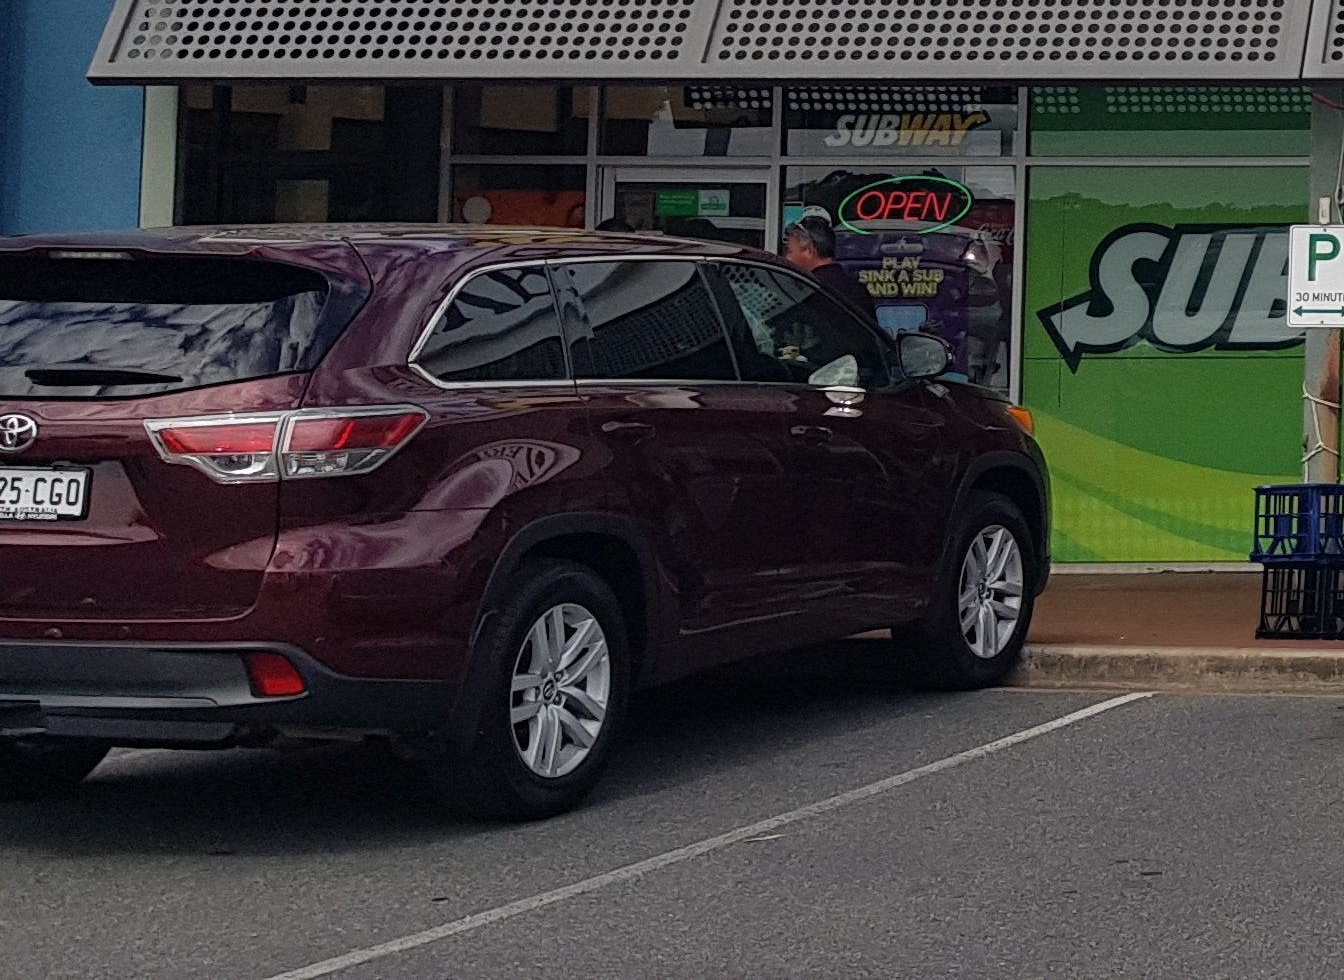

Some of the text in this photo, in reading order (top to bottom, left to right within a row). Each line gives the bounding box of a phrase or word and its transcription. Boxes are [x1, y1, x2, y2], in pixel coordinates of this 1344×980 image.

[823, 112, 987, 147] SUBWAY
[856, 189, 953, 220] OPEN
[883, 257, 921, 269] PLAY
[1308, 233, 1341, 281] P
[859, 269, 945, 283] SINK A SUB
[866, 283, 899, 297] AND
[1296, 293, 1310, 301] 30
